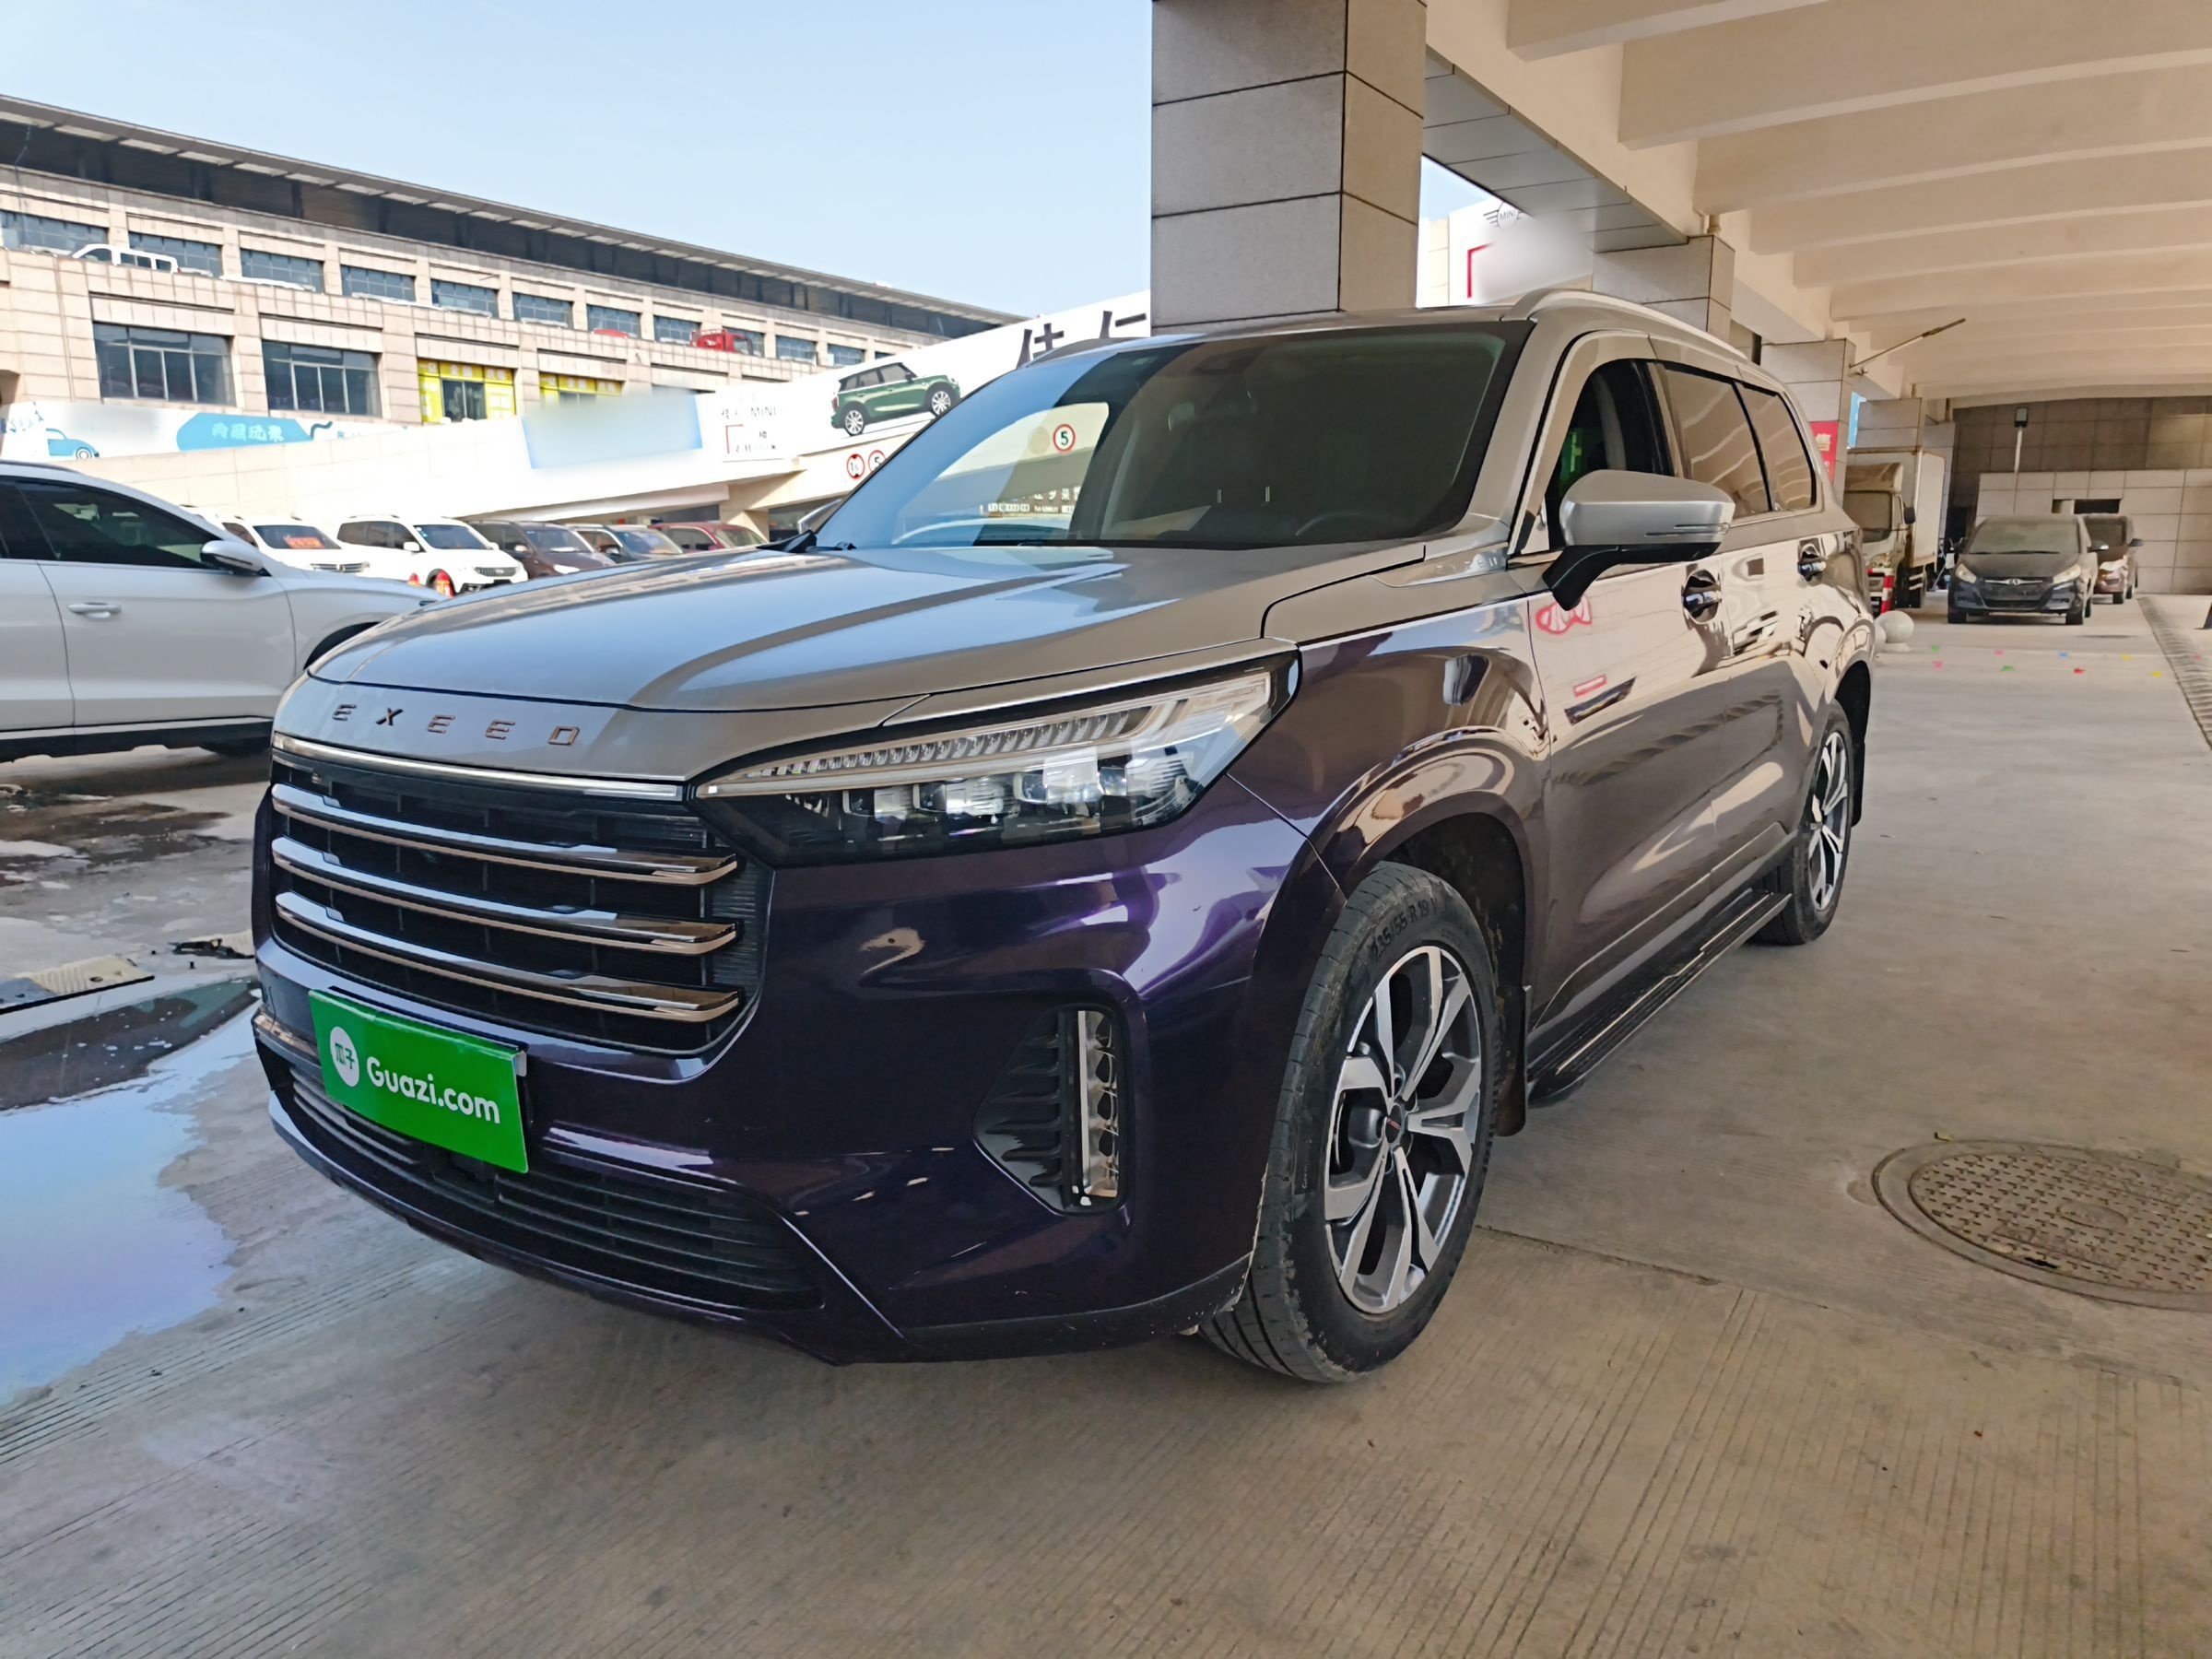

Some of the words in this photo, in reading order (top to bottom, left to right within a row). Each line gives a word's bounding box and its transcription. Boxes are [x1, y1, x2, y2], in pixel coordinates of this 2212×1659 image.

[1500, 209, 1516, 220] MINI
[750, 406, 777, 418] MINI
[1060, 430, 1069, 446] 5
[332, 703, 581, 746] EXEED
[334, 1041, 356, 1070] 瓜子
[366, 1056, 500, 1124] Guazi.com
